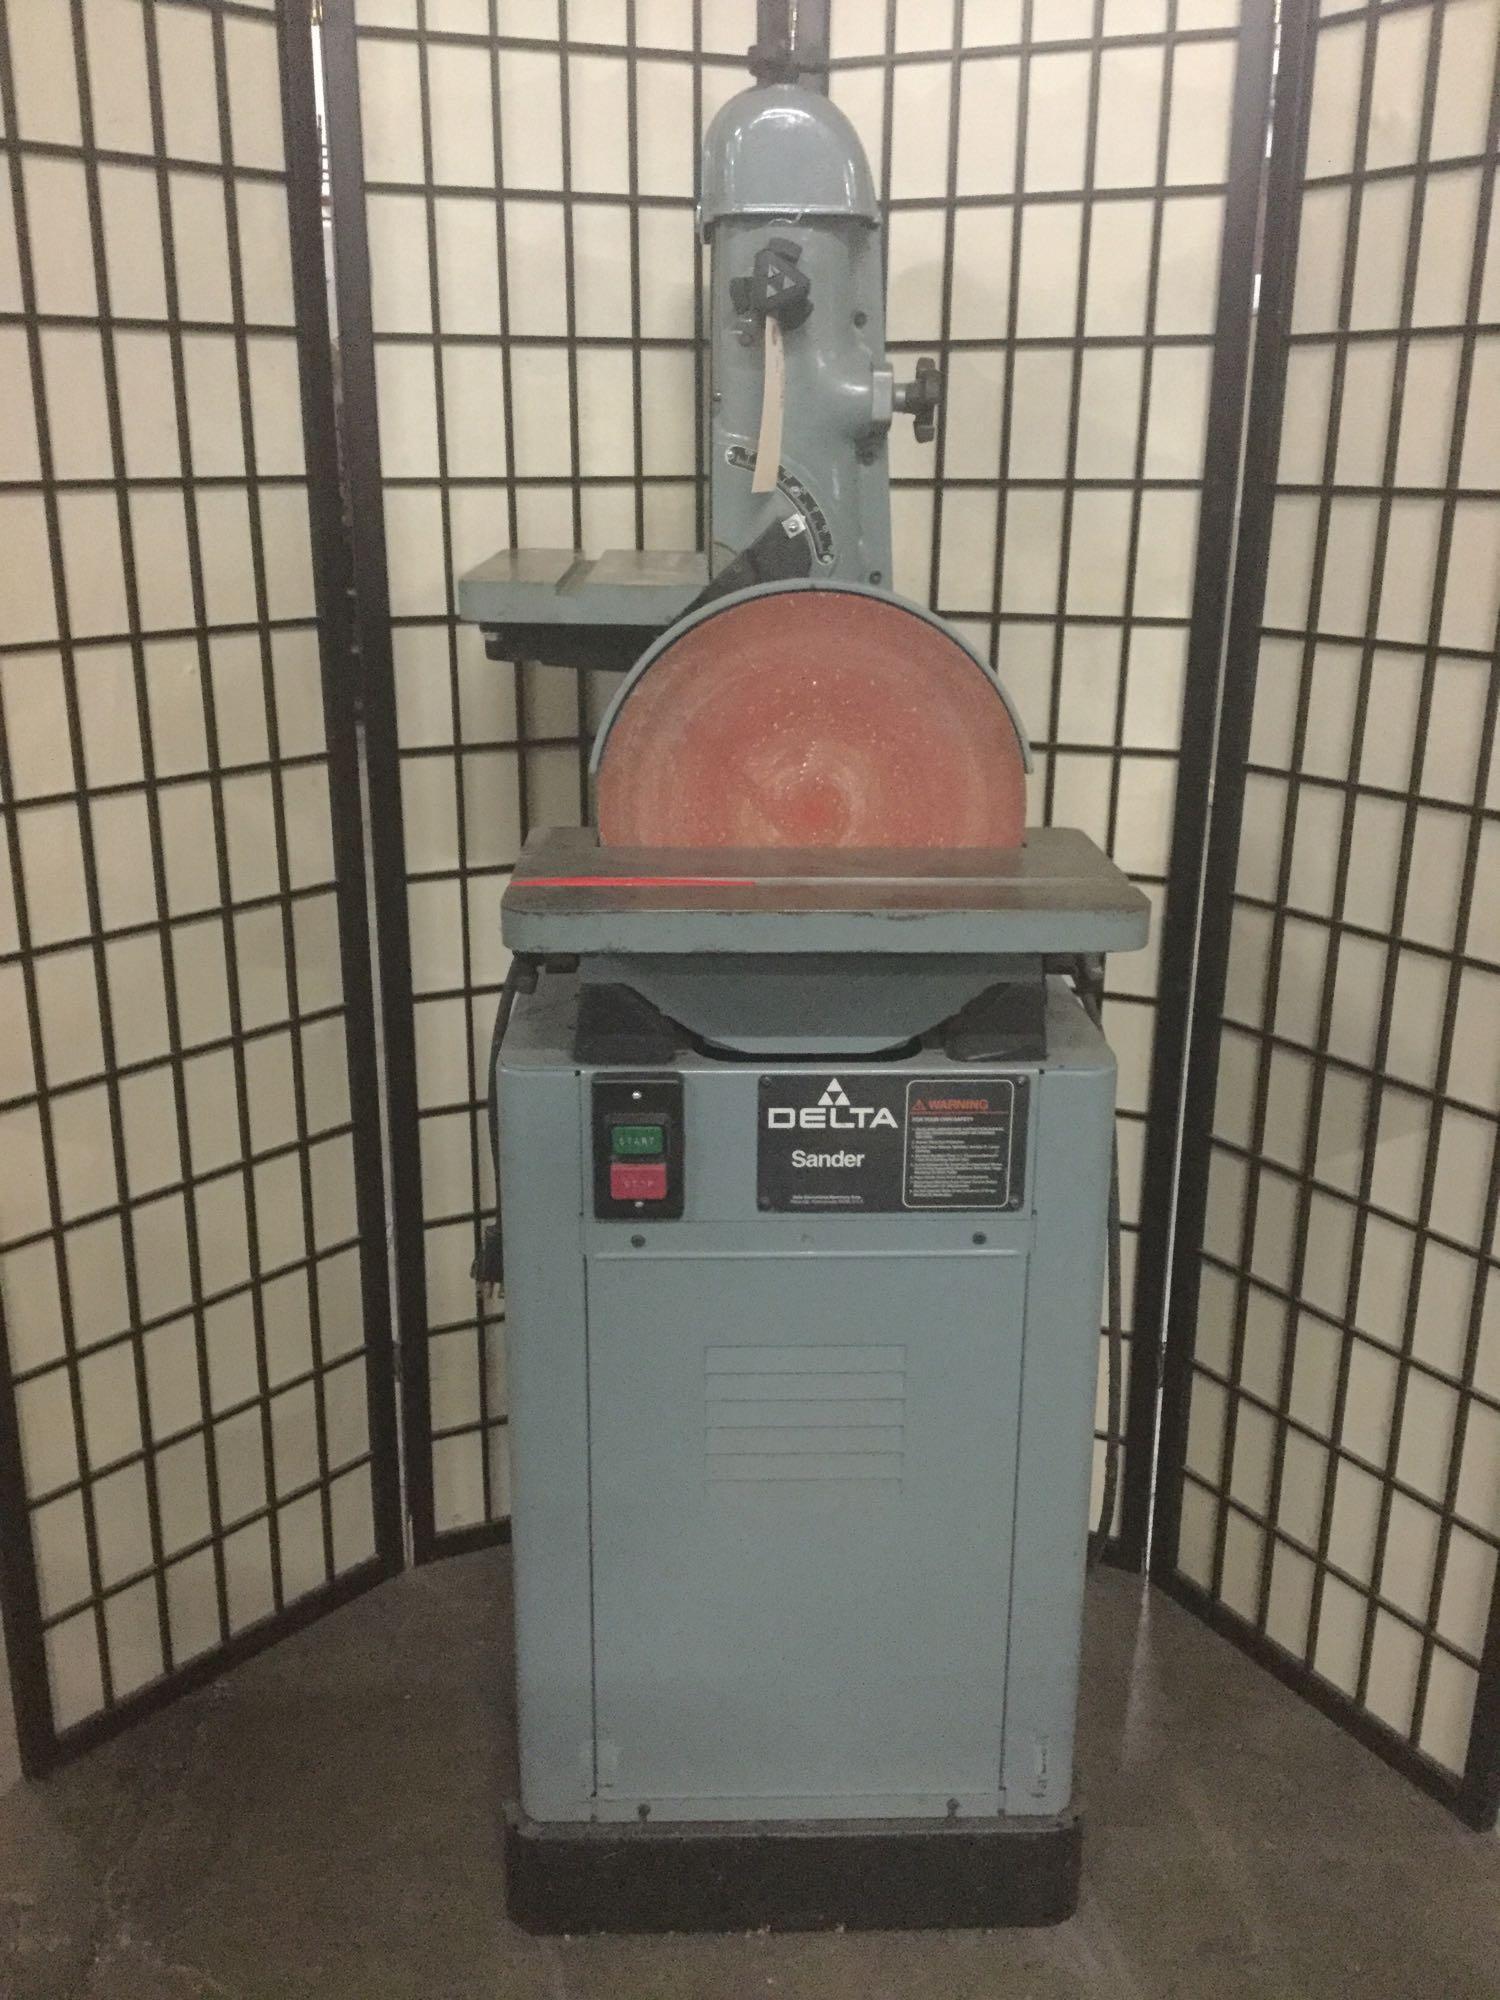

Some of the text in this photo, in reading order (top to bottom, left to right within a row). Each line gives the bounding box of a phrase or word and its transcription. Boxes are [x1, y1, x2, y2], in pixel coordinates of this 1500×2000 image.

[928, 1098, 989, 1109] WARNING
[768, 1107, 898, 1128] DELTA
[619, 1136, 655, 1147] START
[791, 1149, 865, 1168] Sander
